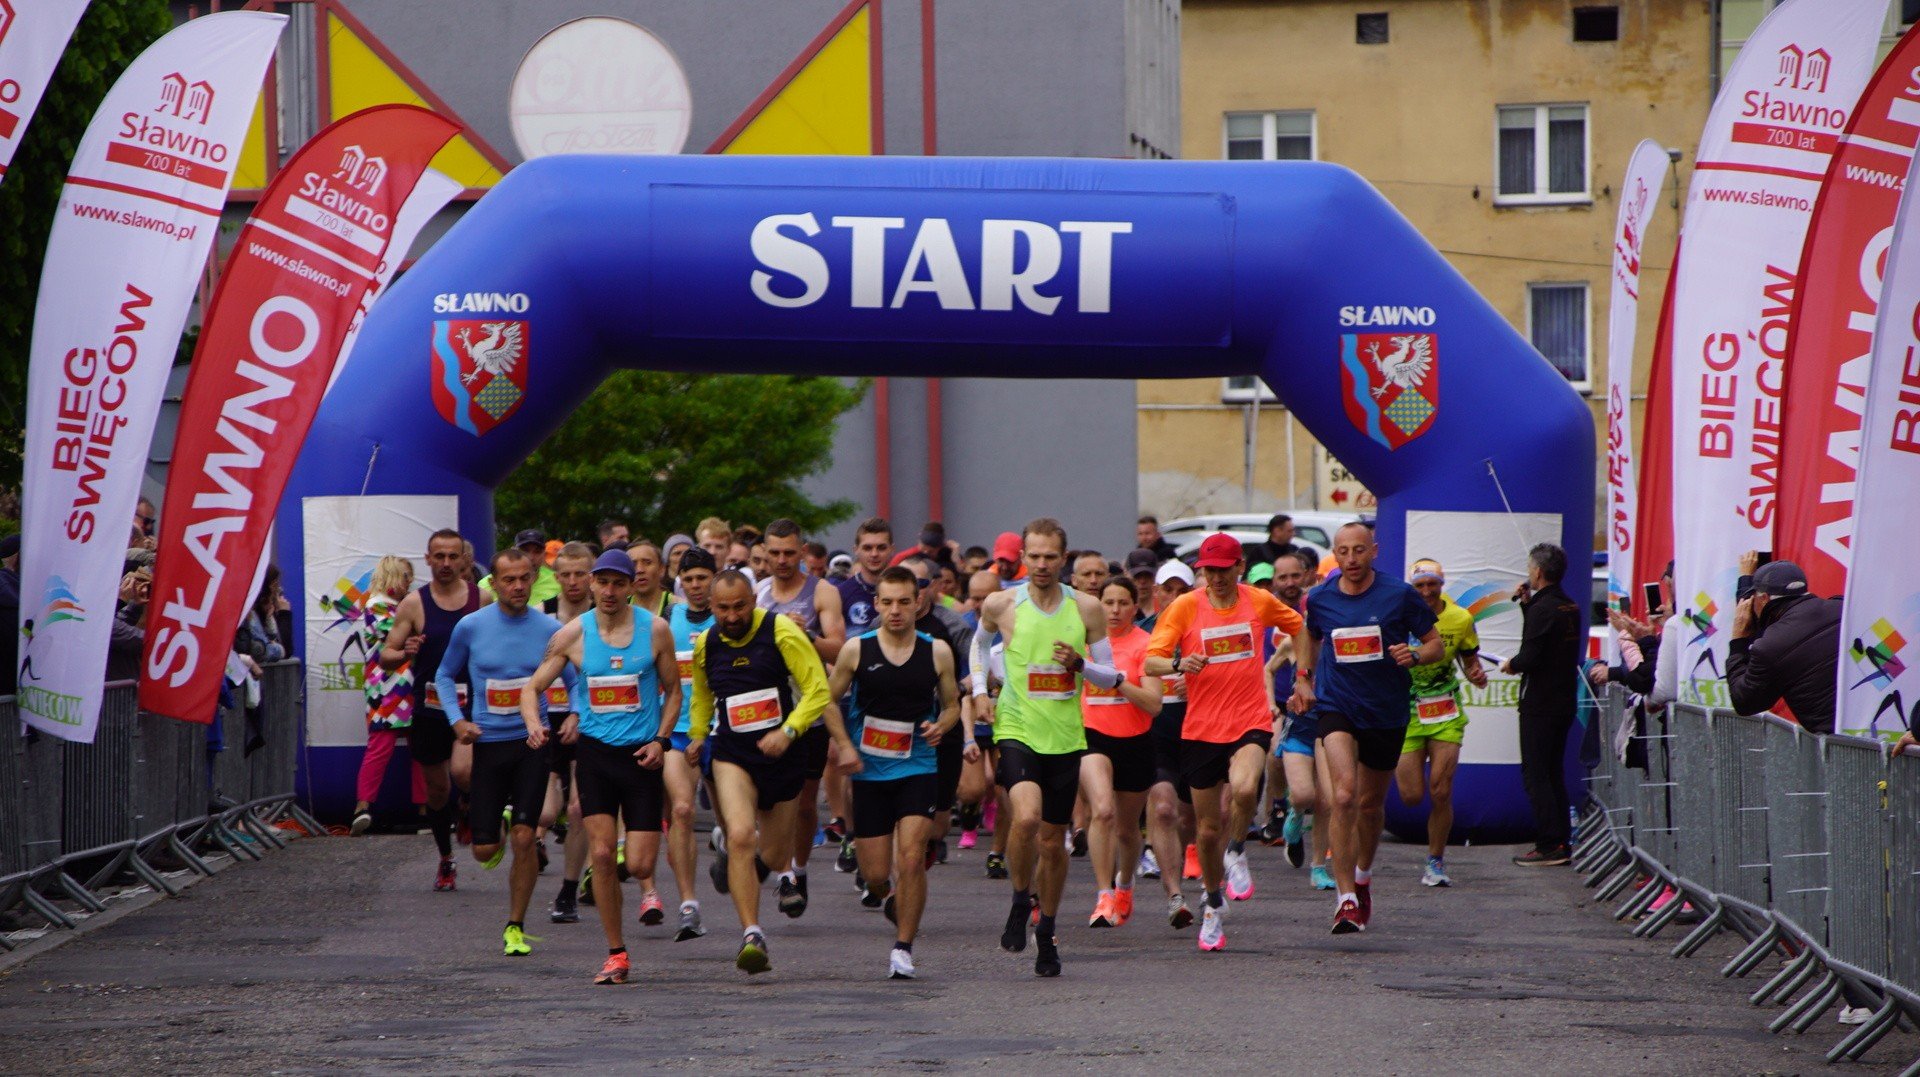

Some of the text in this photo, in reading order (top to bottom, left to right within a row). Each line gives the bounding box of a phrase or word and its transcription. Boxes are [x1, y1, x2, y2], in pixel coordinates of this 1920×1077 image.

[1742, 90, 1846, 129] Sławno
[119, 111, 227, 163] Sławno
[1766, 129, 1816, 149] 700 lat
[143, 152, 193, 178] 700 lat
[299, 172, 388, 232] Sławno
[1704, 188, 1812, 212] www.slawno.
[73, 203, 197, 241] www.slawno.pl
[316, 210, 354, 239] 700 lat
[750, 211, 1133, 316] START
[433, 292, 530, 313] SŁAWNO
[1339, 306, 1436, 326] SŁAWNO
[1700, 332, 1740, 458] BIEG
[52, 347, 97, 471] BIEG
[63, 283, 154, 544] ŚWIĘCÓW
[148, 295, 321, 688] SŁAWNO
[1213, 640, 1230, 654] 52
[1342, 641, 1358, 655] 42
[597, 690, 615, 702] 99
[738, 706, 756, 721] 93
[871, 732, 888, 746] 78
